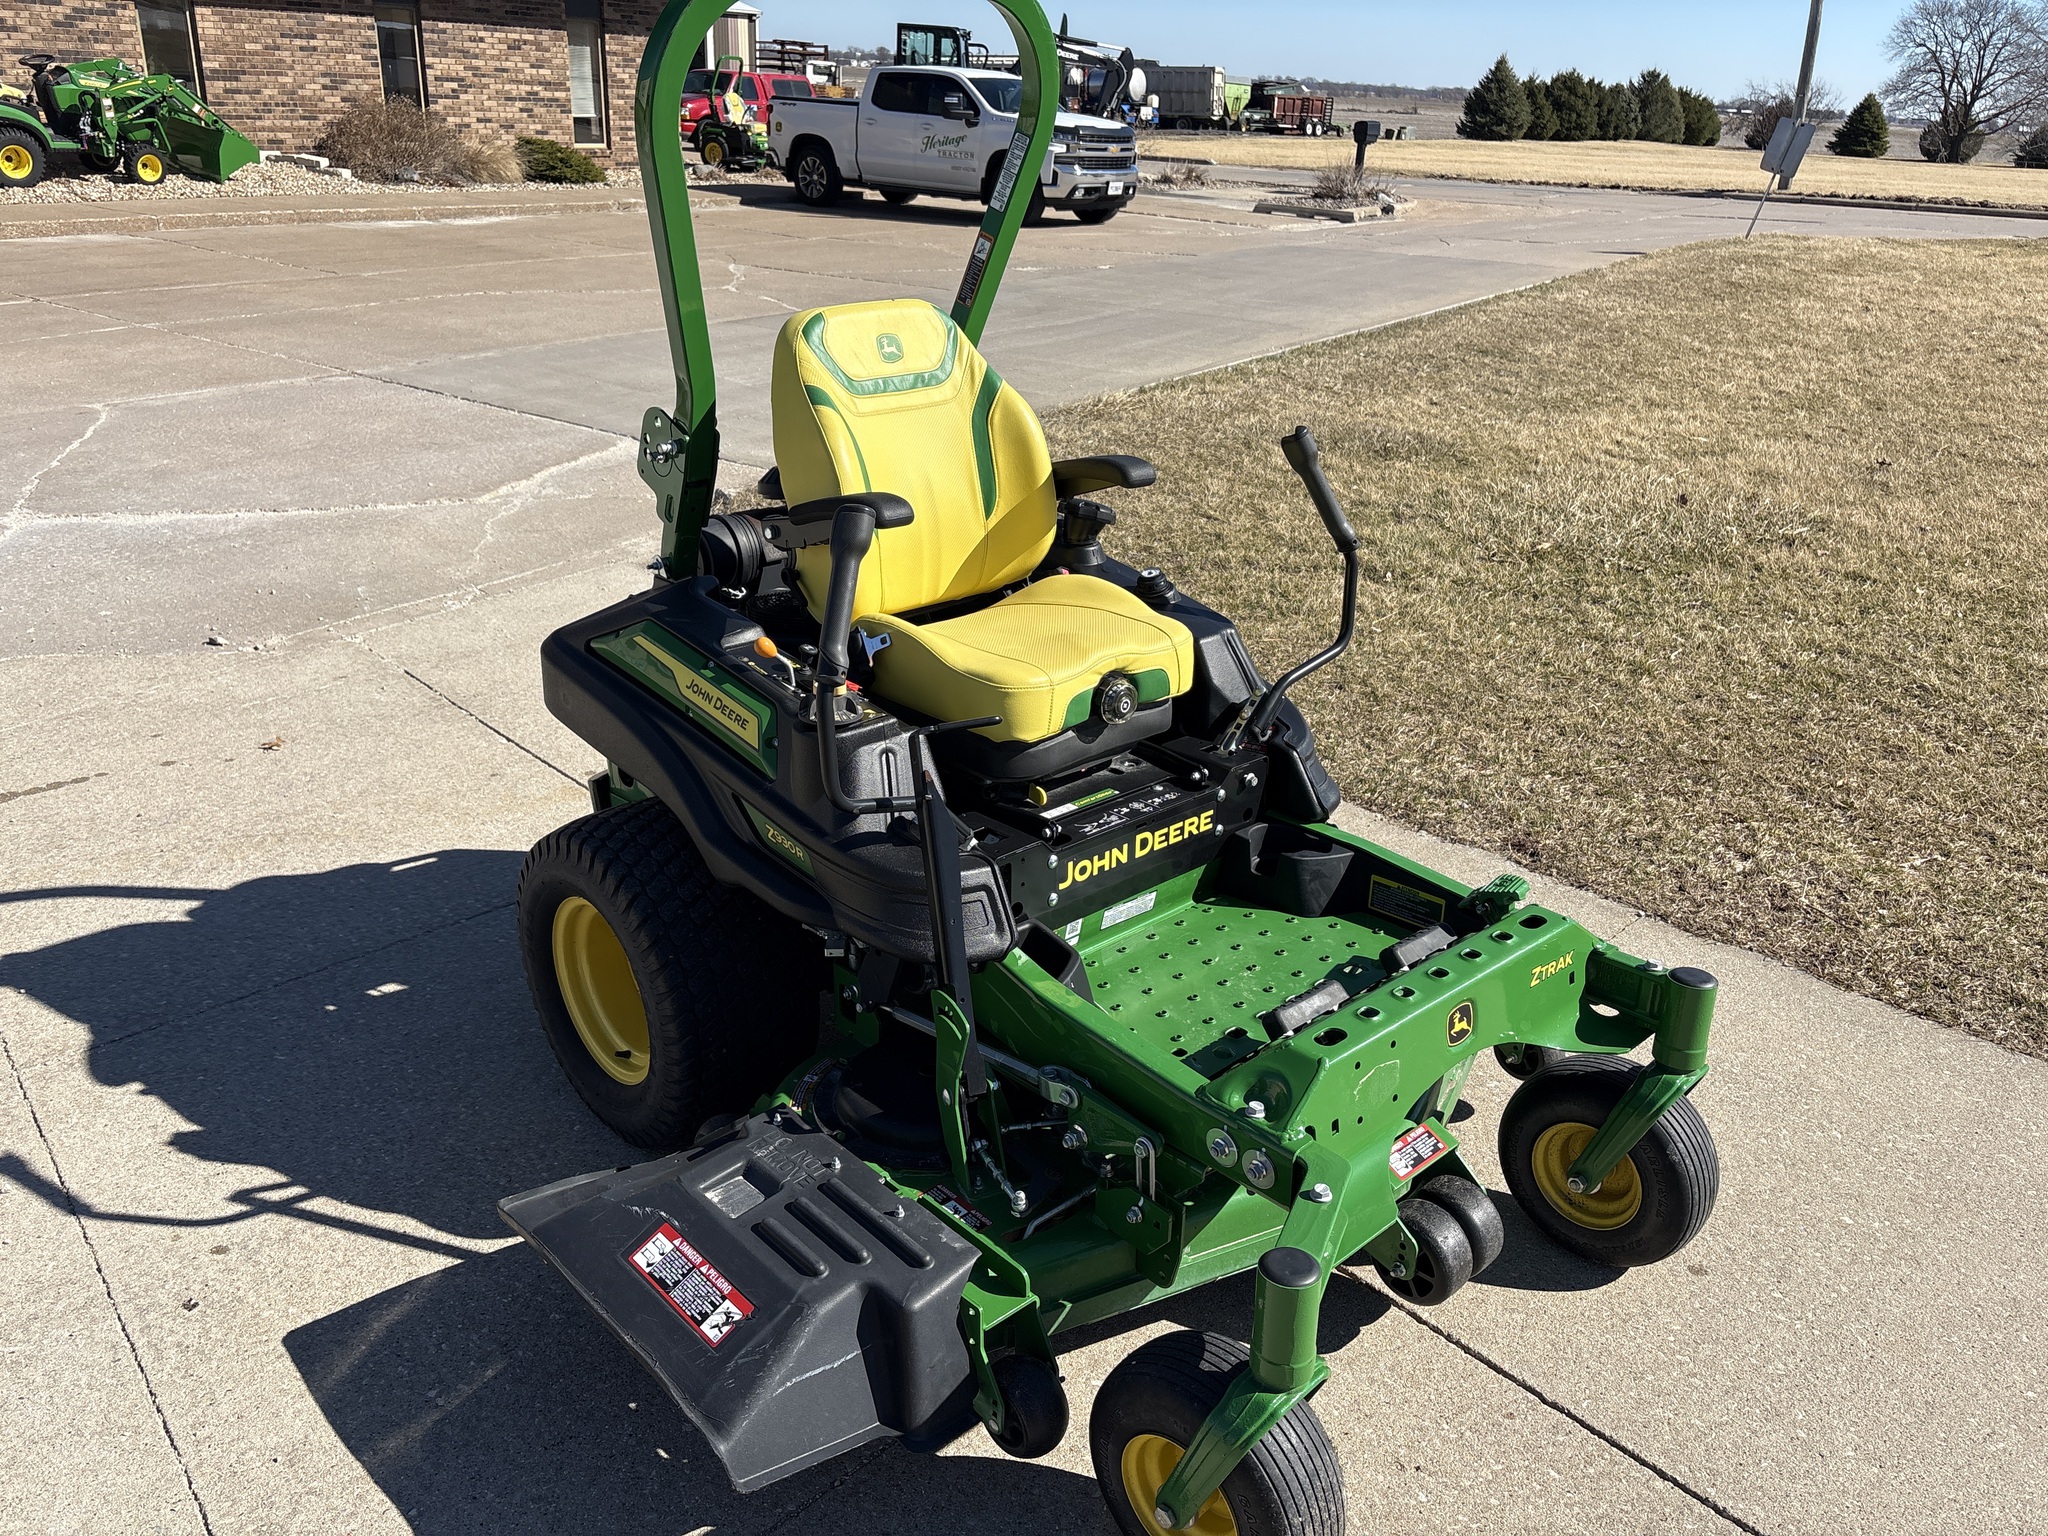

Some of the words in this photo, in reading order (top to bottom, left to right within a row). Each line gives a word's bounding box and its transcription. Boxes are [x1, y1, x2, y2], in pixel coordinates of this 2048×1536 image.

[921, 134, 968, 154] Heritage
[937, 150, 975, 160] TRACTOR
[685, 679, 714, 705] JOHN
[713, 697, 749, 731] DEERE
[765, 824, 805, 861] Z930R
[1058, 842, 1129, 891] JOHN
[1134, 809, 1214, 859] DEERE
[1530, 949, 1575, 988] ZTRAK
[746, 1137, 817, 1190] REMOVE
[763, 1130, 794, 1151] DO
[790, 1149, 828, 1178] NOT
[1638, 1143, 1669, 1223] ARLISLE
[680, 1241, 703, 1266] DANGER
[706, 1268, 732, 1295] PELIGRO
